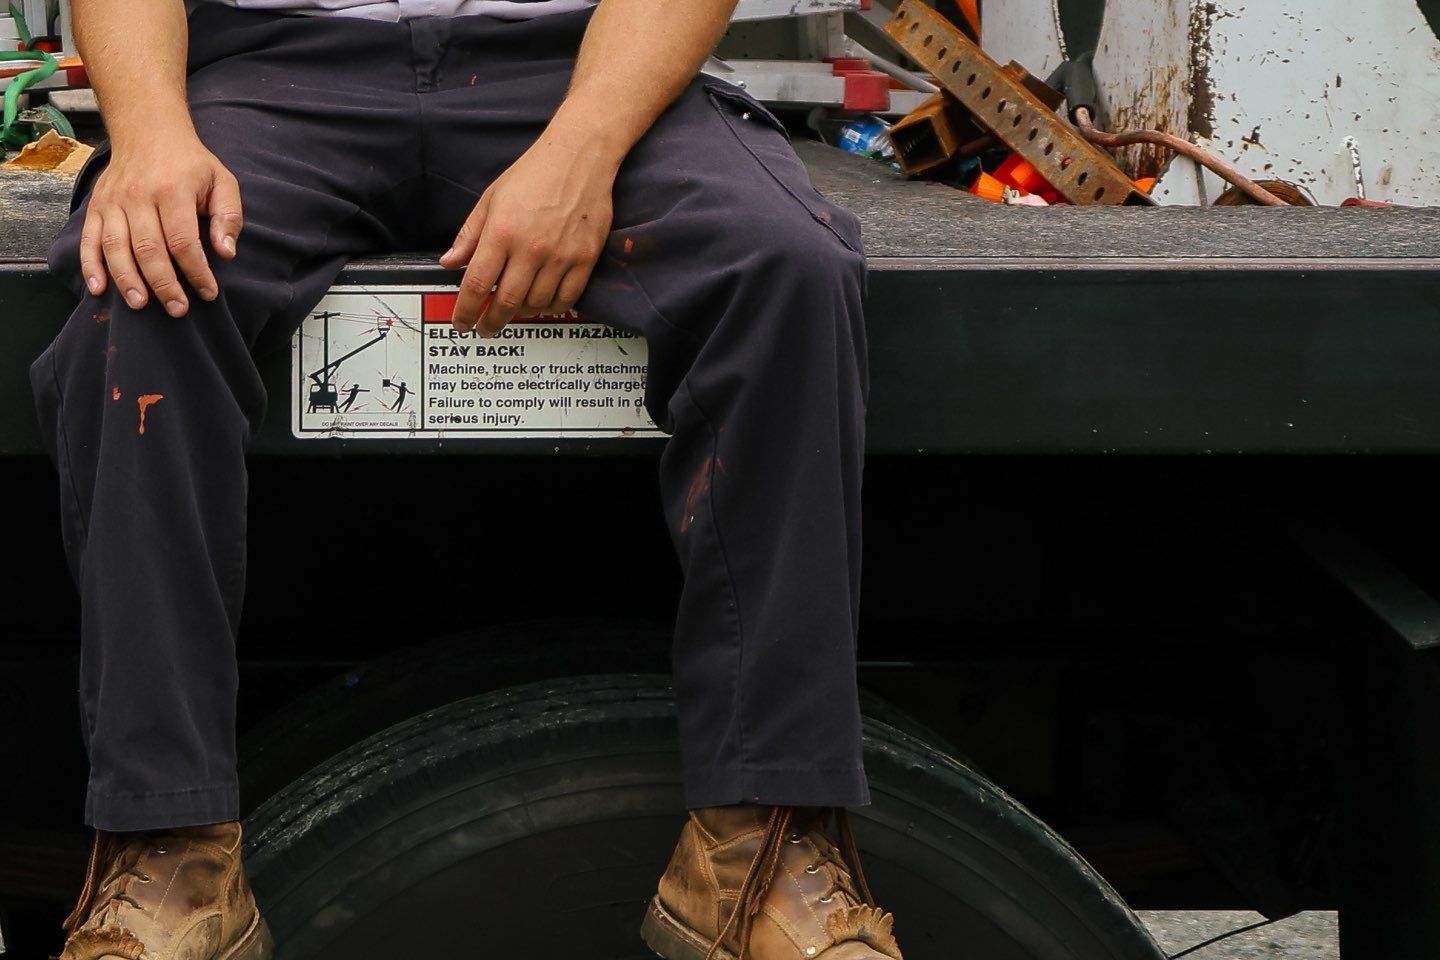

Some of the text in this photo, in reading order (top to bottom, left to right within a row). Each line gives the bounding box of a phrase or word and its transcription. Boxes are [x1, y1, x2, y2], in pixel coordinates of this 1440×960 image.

[429, 328, 563, 339] ELECTCUTION
[429, 346, 525, 357] STAY BACK!
[429, 363, 648, 376] Machine, truck or truck attachme
[429, 381, 457, 392] may
[461, 379, 514, 390] become
[517, 379, 591, 392] electrically
[429, 397, 475, 408] Failure
[479, 397, 492, 408] to
[496, 397, 545, 410] comply
[549, 397, 571, 407] will
[576, 397, 614, 407] result
[618, 397, 630, 407] in
[429, 413, 525, 426] serious injury.
